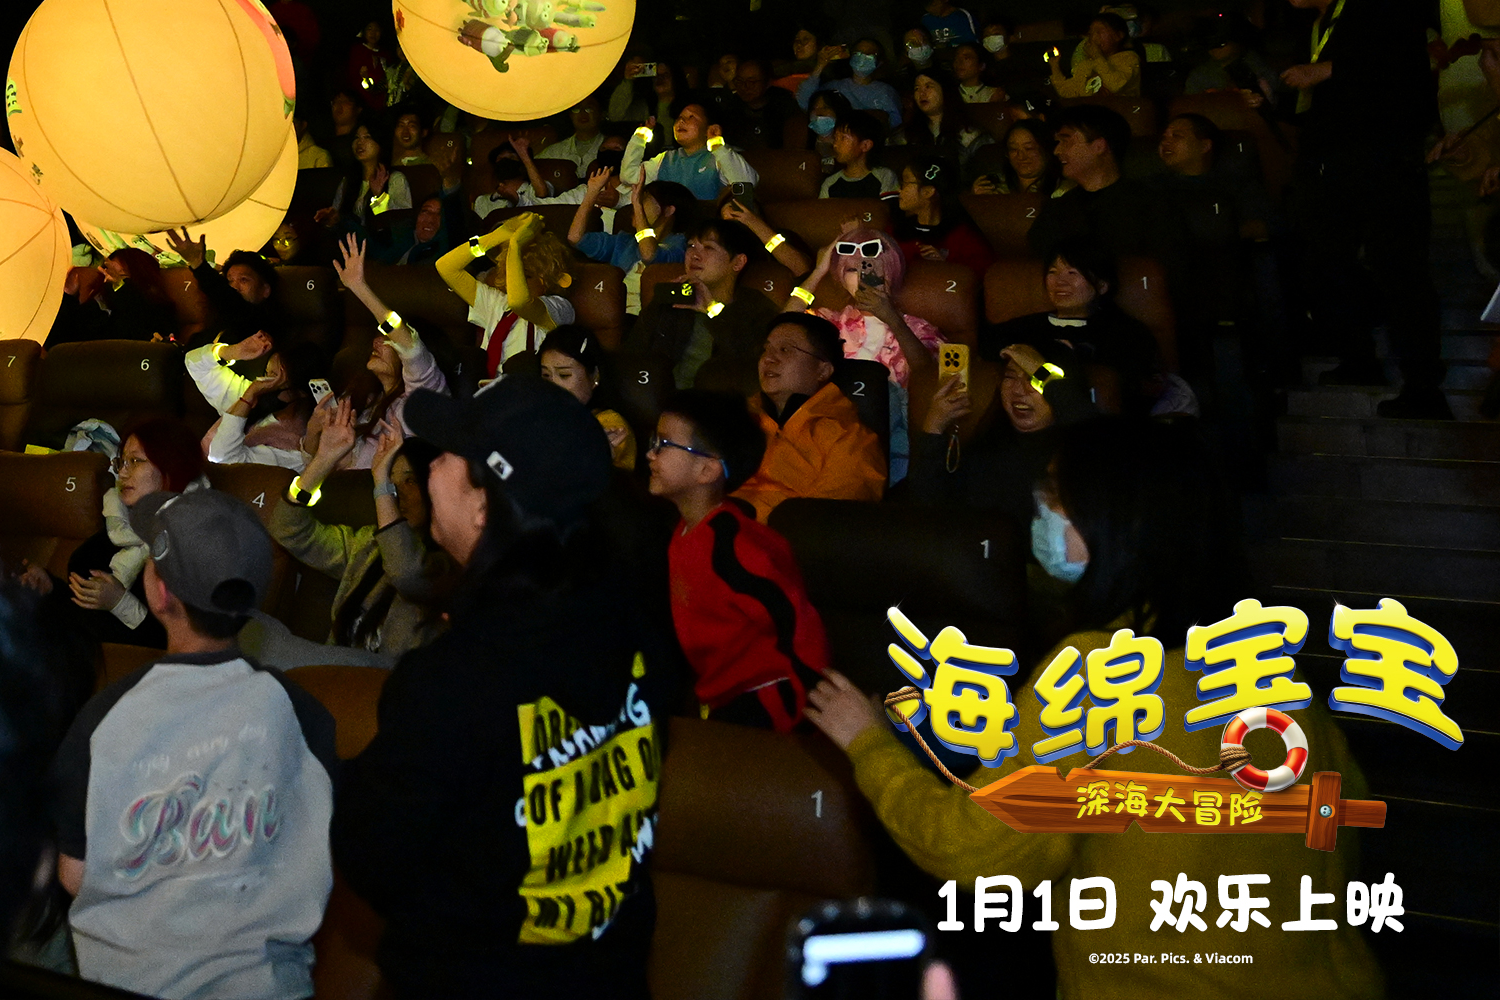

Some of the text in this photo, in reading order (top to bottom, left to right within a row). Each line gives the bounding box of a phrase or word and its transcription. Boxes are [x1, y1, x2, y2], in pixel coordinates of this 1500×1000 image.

[1025, 207, 1036, 218] 2
[1213, 202, 1219, 215] 1
[863, 212, 872, 223] 3
[184, 280, 192, 292] 7
[306, 279, 315, 291] 6
[594, 280, 604, 293] 4
[763, 280, 774, 292] 3
[945, 280, 957, 293] 2
[1141, 276, 1148, 290] 1
[7, 355, 16, 368] 7
[140, 359, 150, 371] 6
[638, 370, 650, 385] 3
[852, 381, 866, 397] 2
[65, 476, 76, 492] 5
[252, 492, 265, 509] 4
[980, 539, 990, 559] 1
[530, 778, 562, 825] OF
[811, 790, 823, 818] 1
[546, 824, 614, 883] WEED
